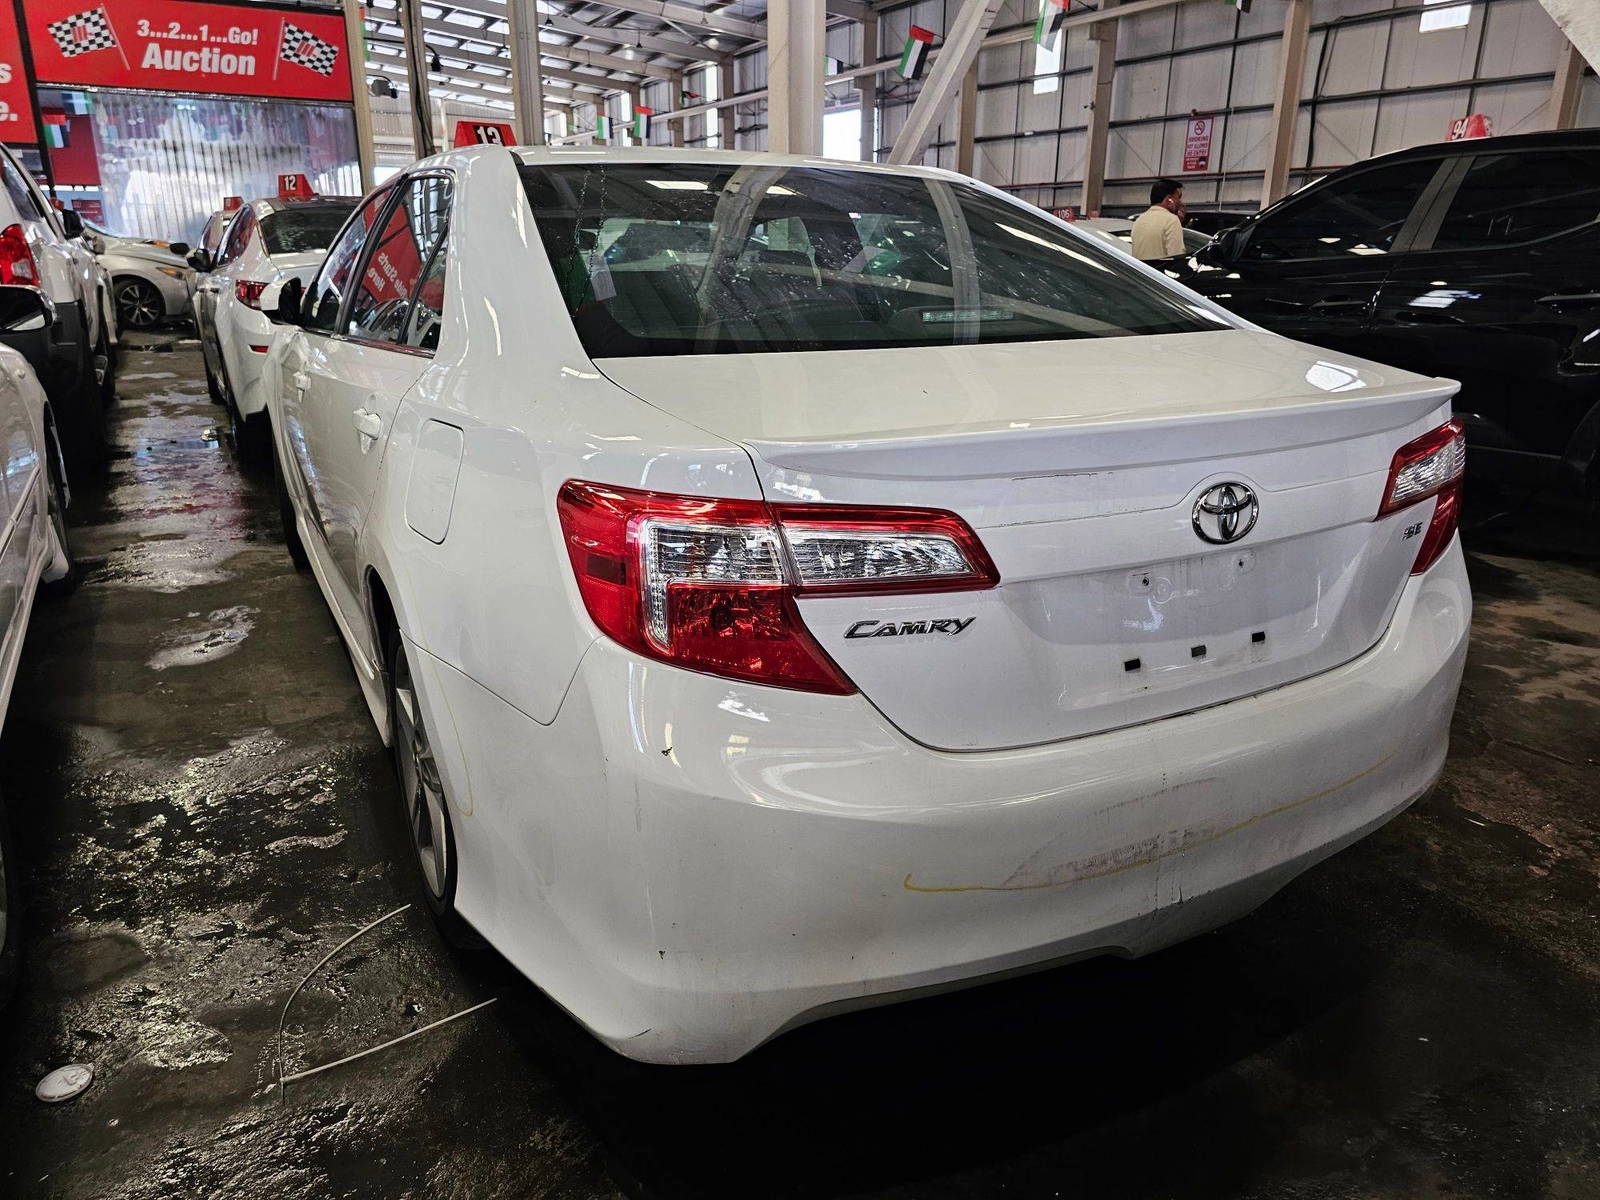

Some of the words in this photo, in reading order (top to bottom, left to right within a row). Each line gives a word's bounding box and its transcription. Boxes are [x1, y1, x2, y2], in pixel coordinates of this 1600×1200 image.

[141, 42, 256, 76] Auction
[477, 126, 502, 145] 13
[1452, 118, 1469, 140] 94
[284, 175, 296, 191] 12
[844, 616, 977, 638] CAMRY
